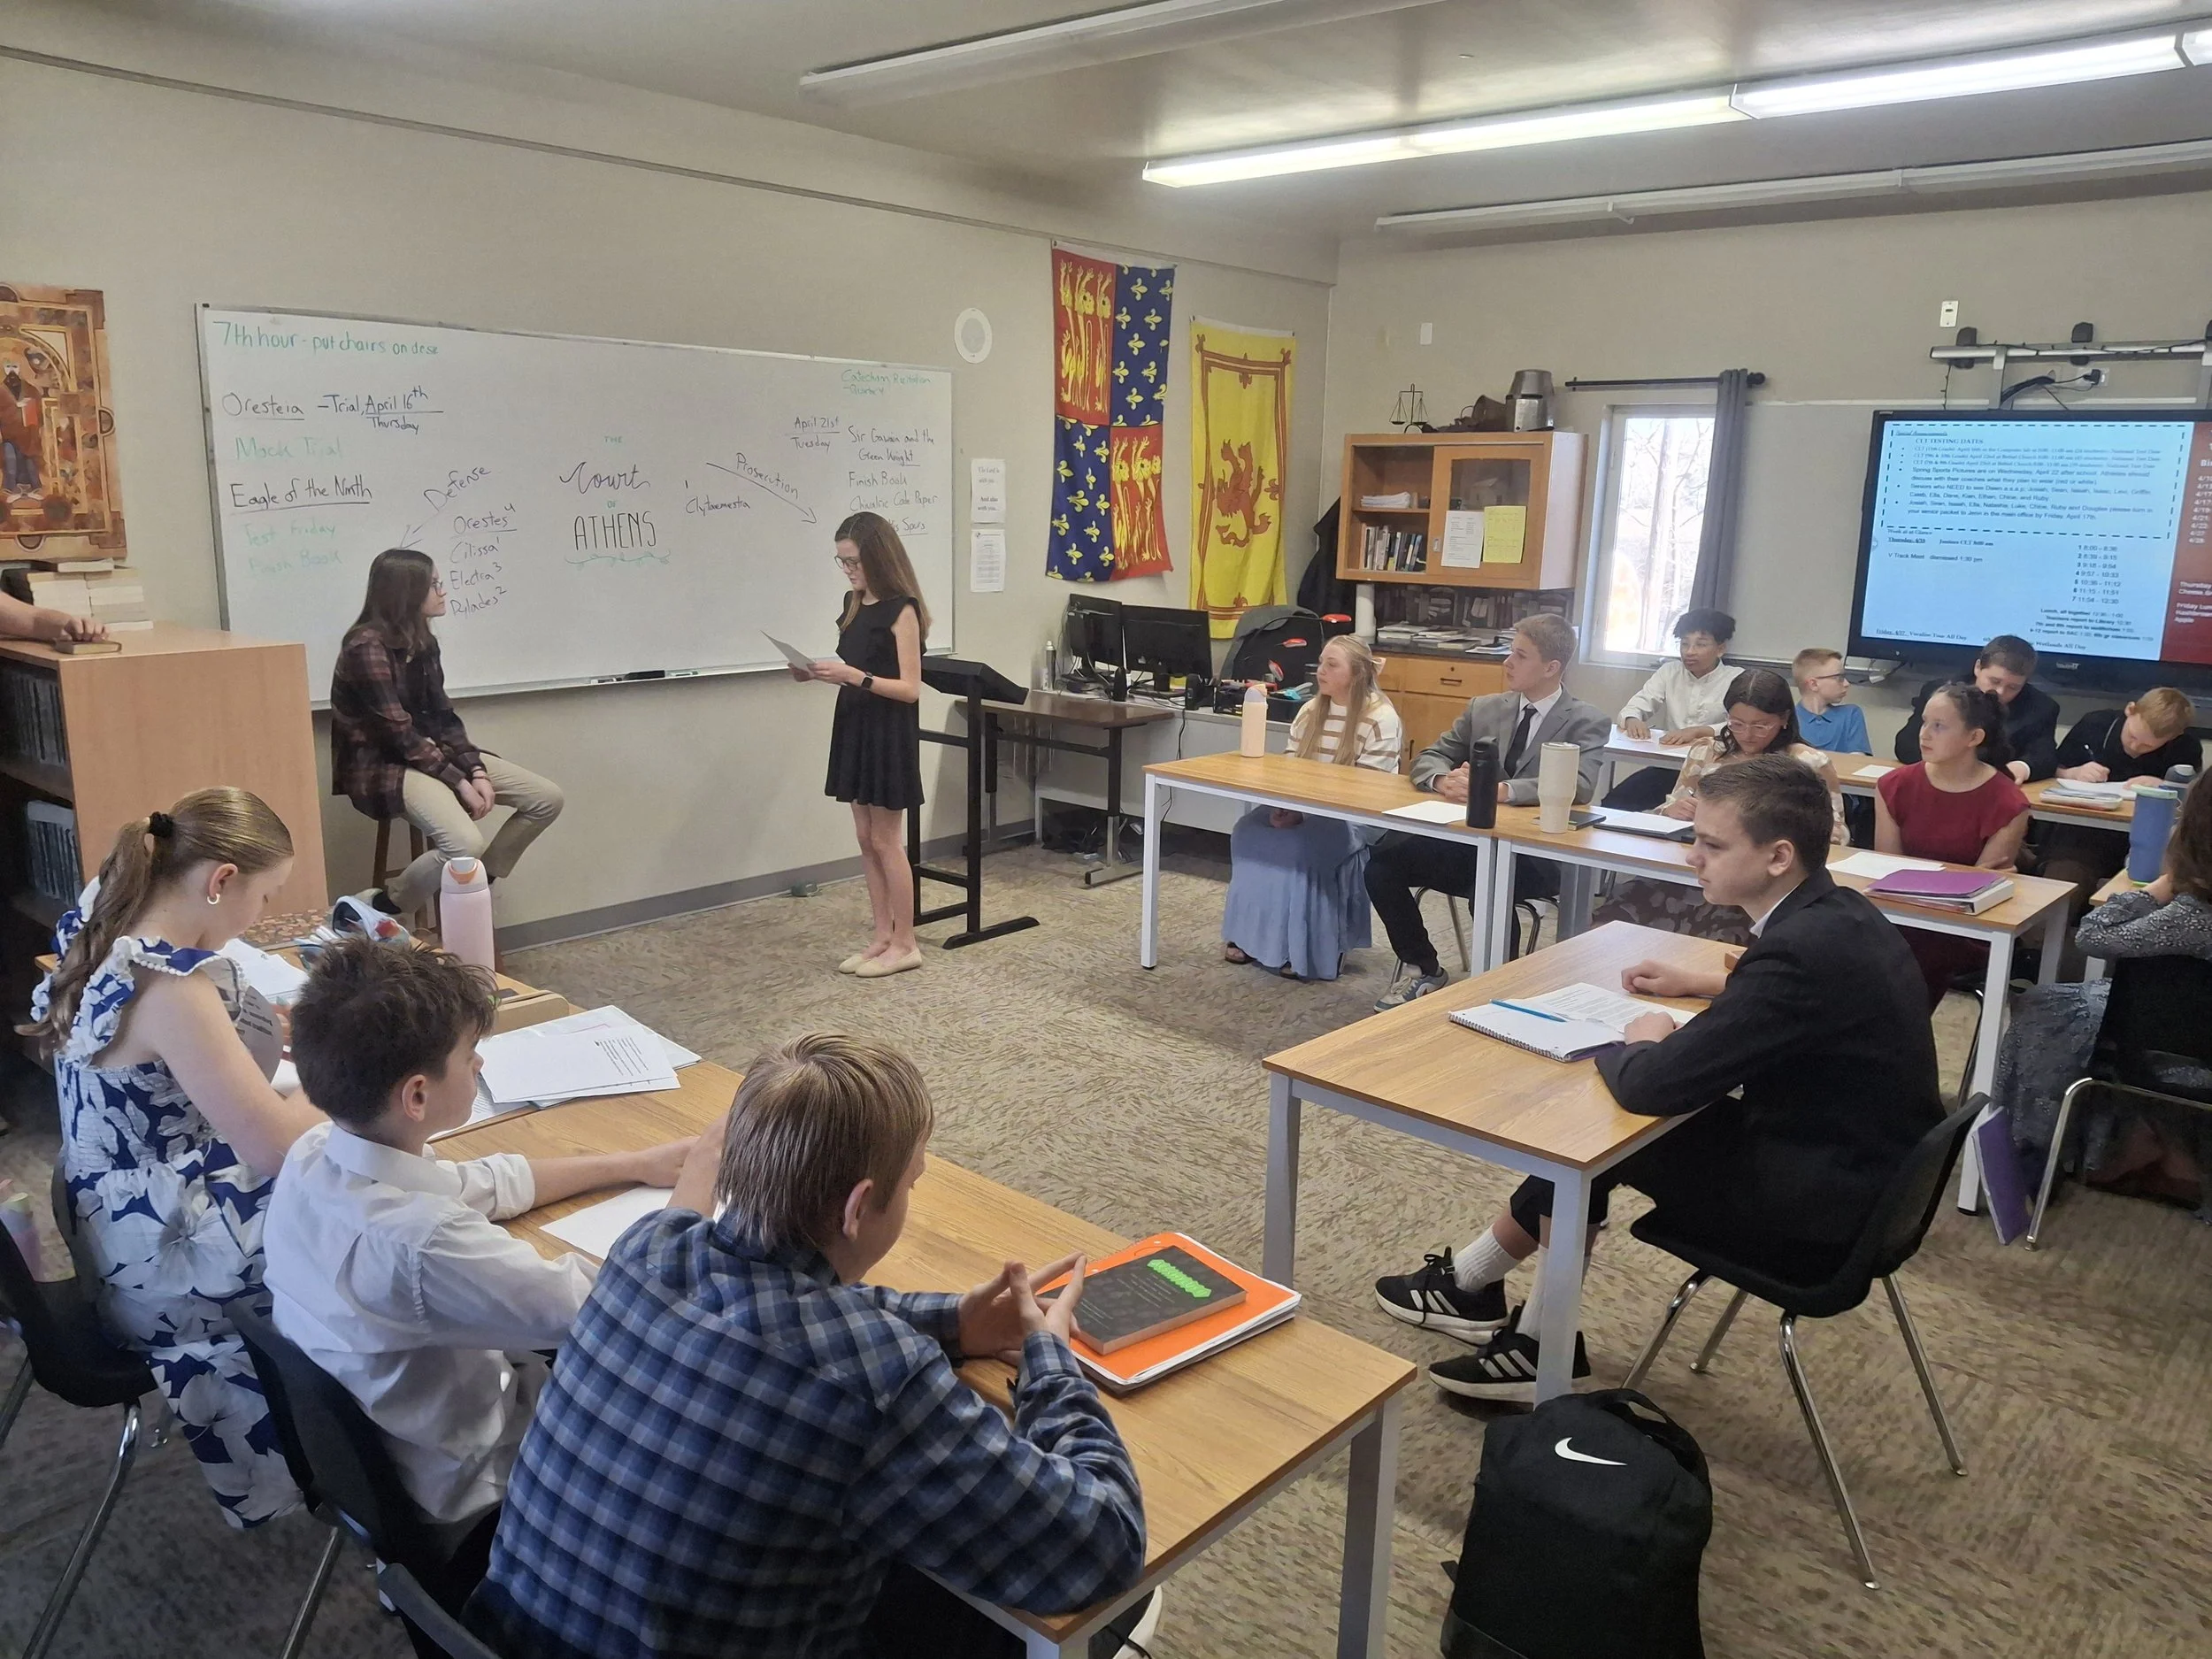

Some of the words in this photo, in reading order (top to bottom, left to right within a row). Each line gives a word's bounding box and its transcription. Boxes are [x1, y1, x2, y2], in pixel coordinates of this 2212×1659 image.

[213, 321, 253, 347] 7th
[257, 326, 297, 348] hour
[312, 335, 335, 351] put
[339, 331, 386, 352] chairs
[392, 342, 407, 355] on
[221, 392, 305, 416] Oresteia
[365, 395, 397, 417] April
[366, 416, 419, 434] Thursday
[795, 417, 817, 432] April
[820, 416, 839, 428] 21st
[849, 425, 865, 443] Sir
[871, 428, 901, 442] Gawain
[904, 429, 919, 442] and
[236, 437, 294, 460] Mock
[791, 435, 830, 452] Tuesday
[859, 449, 883, 461] Green
[735, 452, 798, 499] Prosecution
[849, 471, 878, 487] Finish
[881, 471, 908, 486] Book
[230, 482, 280, 509] Eagle
[285, 478, 300, 502] of
[305, 478, 329, 497] the
[424, 466, 492, 511] Defense
[915, 490, 937, 507] Paper
[574, 511, 657, 551] ATHENS
